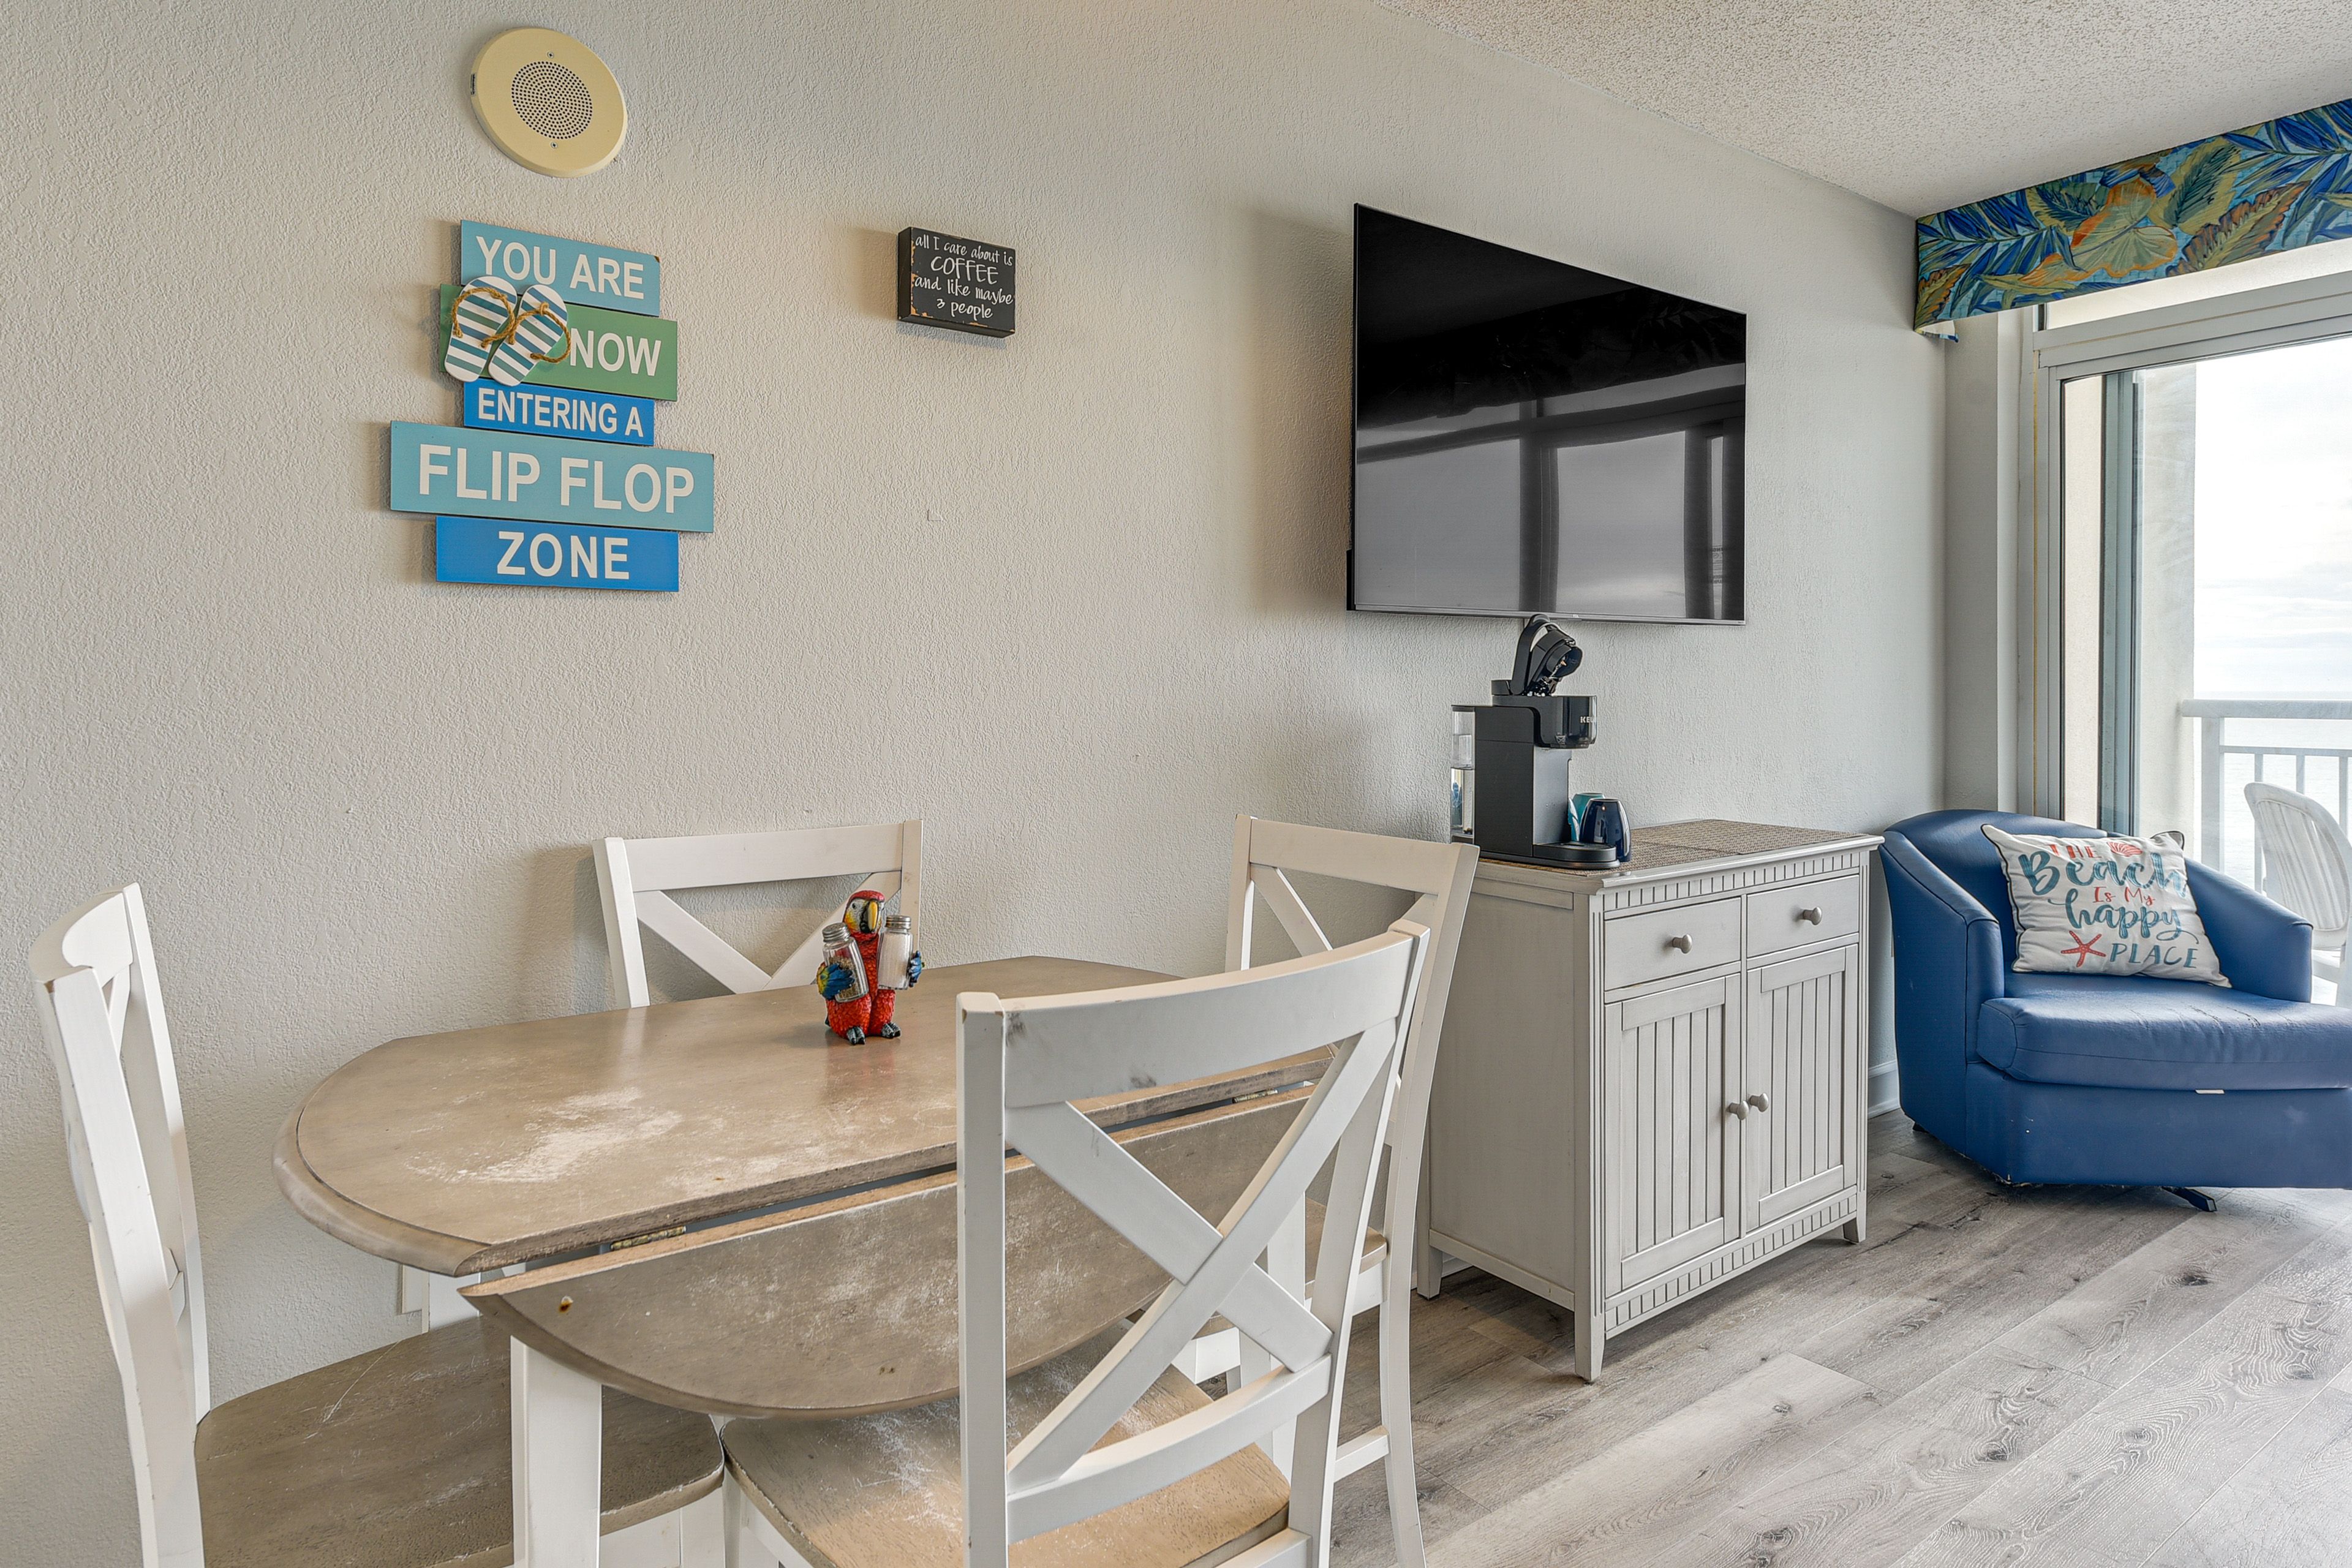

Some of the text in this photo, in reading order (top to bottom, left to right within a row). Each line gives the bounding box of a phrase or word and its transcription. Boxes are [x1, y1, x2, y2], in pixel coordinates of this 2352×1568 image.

[475, 235, 645, 300] YOU ARE
[915, 234, 1013, 266] all I care about is
[930, 256, 998, 284] COFFEE
[914, 276, 1014, 305] and like maybe
[936, 298, 993, 321] 3 people
[569, 328, 662, 377] NOW
[478, 388, 644, 438] ENTERING A
[419, 443, 695, 514] FLIP FLOP
[496, 530, 630, 580] ZONE
[2046, 843, 2103, 859] THE
[2018, 850, 2188, 899] Beach
[2047, 888, 2199, 944] happy
[2092, 886, 2156, 906] Is My
[2109, 943, 2198, 968] PLACE
